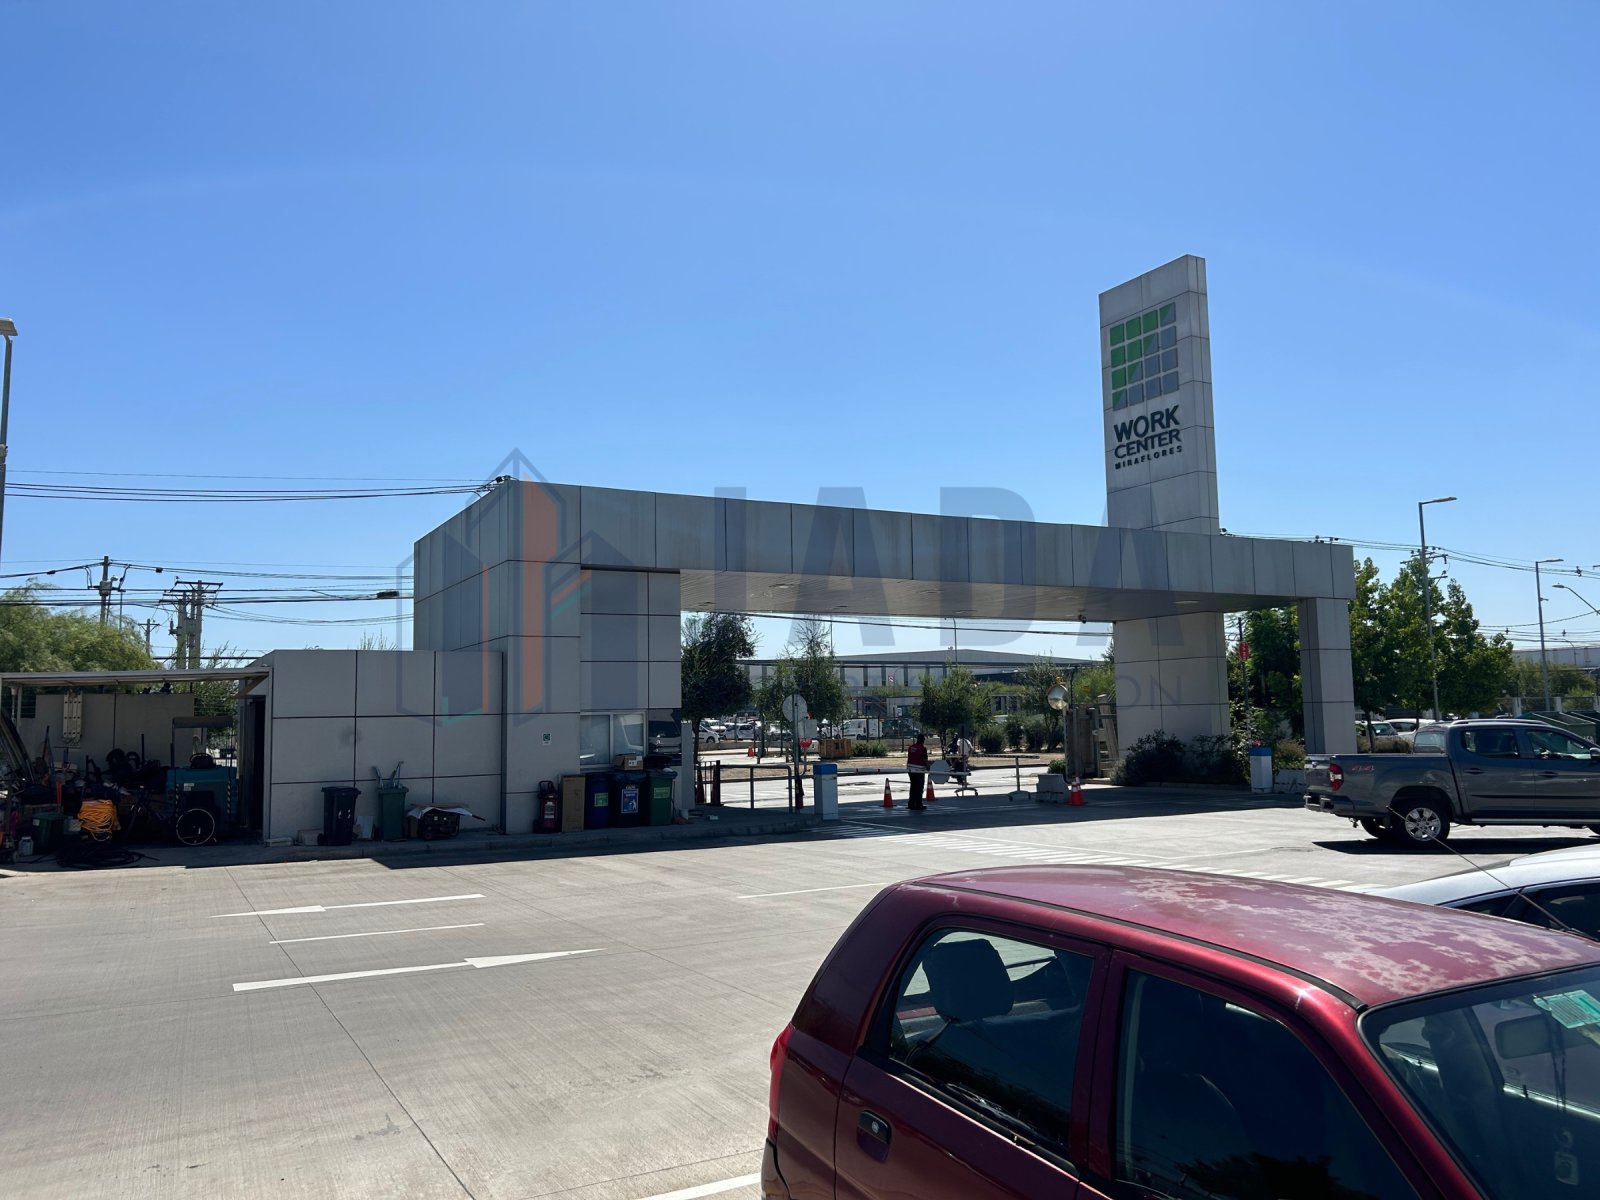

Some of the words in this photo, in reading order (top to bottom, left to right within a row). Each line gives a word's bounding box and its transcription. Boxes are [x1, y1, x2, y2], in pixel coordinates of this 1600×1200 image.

[1113, 404, 1180, 442] WORK
[1114, 429, 1182, 459] CENTER
[1115, 445, 1183, 470] MIRAFLORES
